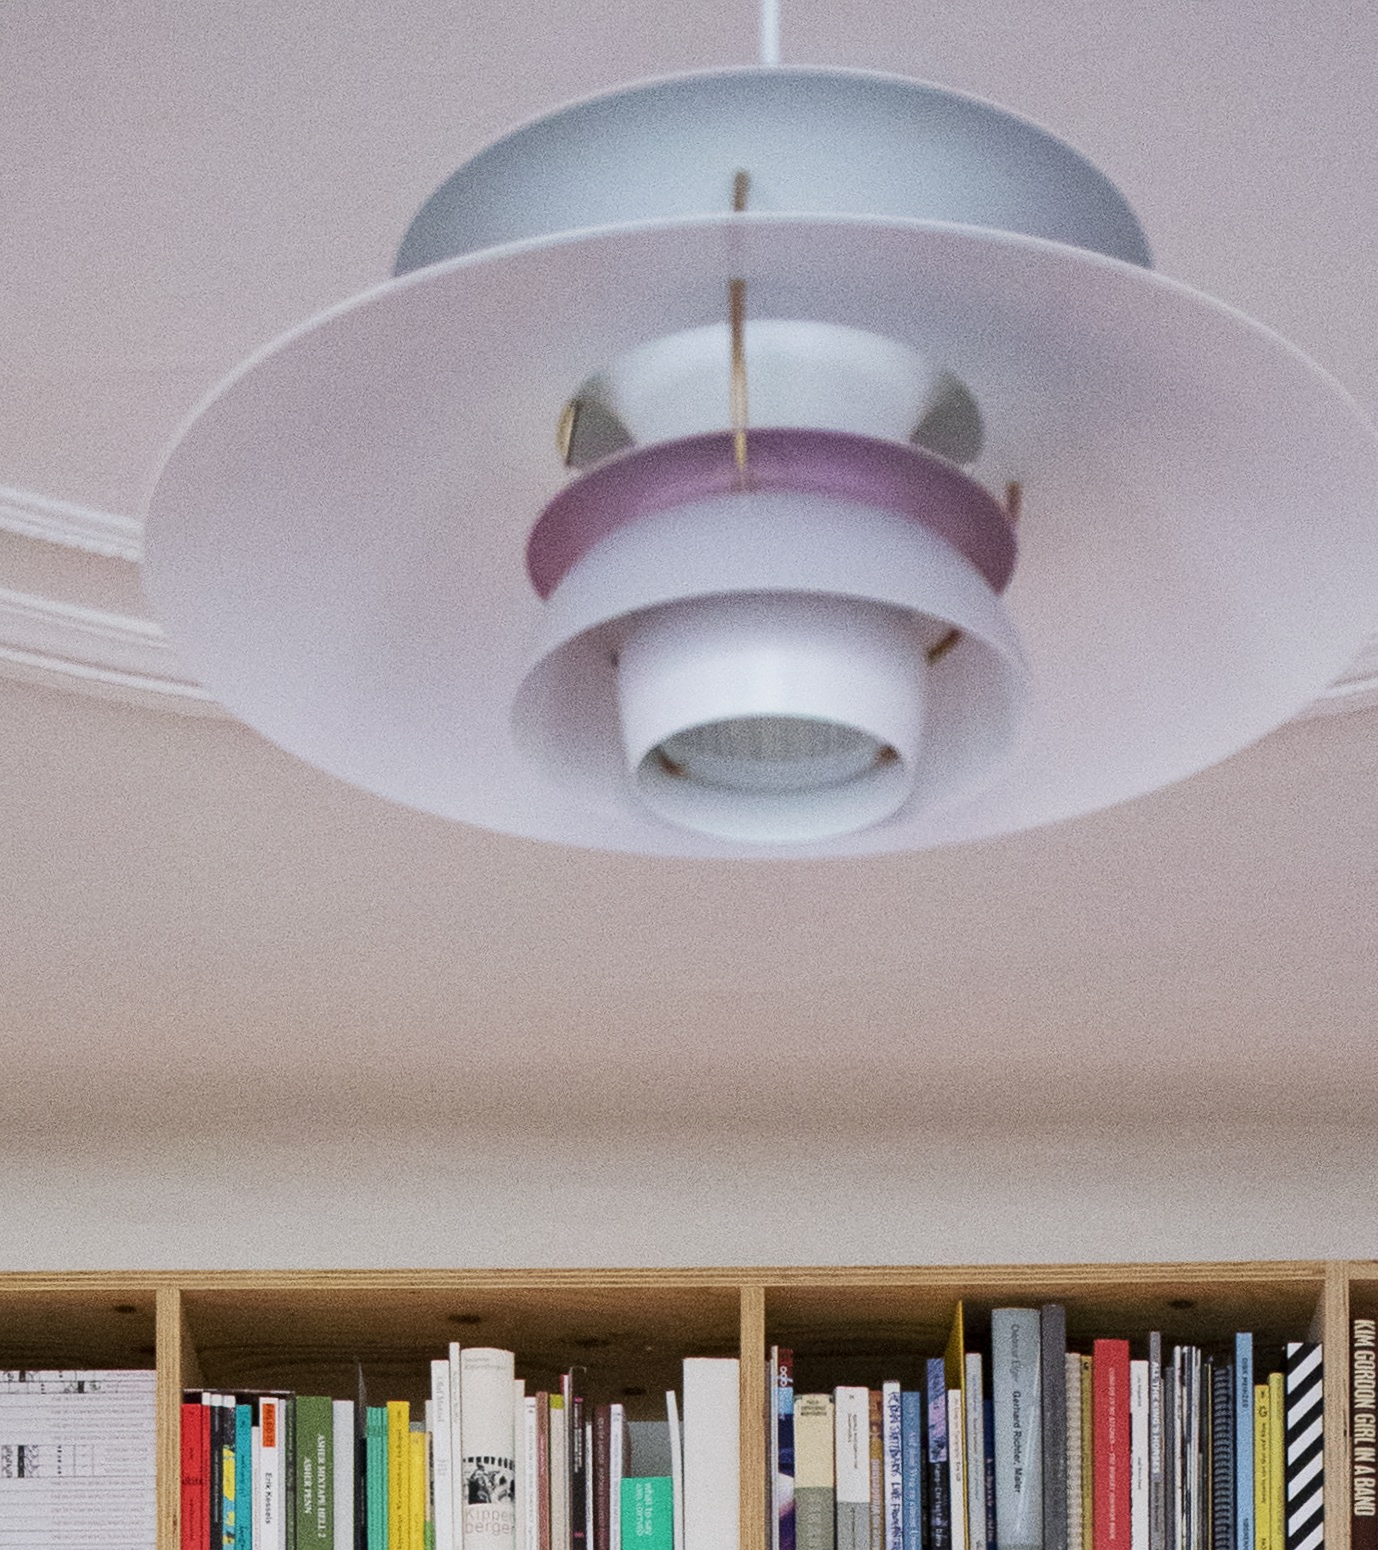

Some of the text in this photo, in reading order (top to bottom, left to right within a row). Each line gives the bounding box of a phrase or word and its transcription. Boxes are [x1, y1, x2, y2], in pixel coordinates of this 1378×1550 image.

[1353, 1319, 1376, 1346] KIM
[1353, 1349, 1376, 1409] GORDON
[1012, 1391, 1022, 1428] Gerhard
[1353, 1413, 1376, 1444] GIRL
[1353, 1447, 1376, 1462] IN
[1353, 1479, 1376, 1516] BAND
